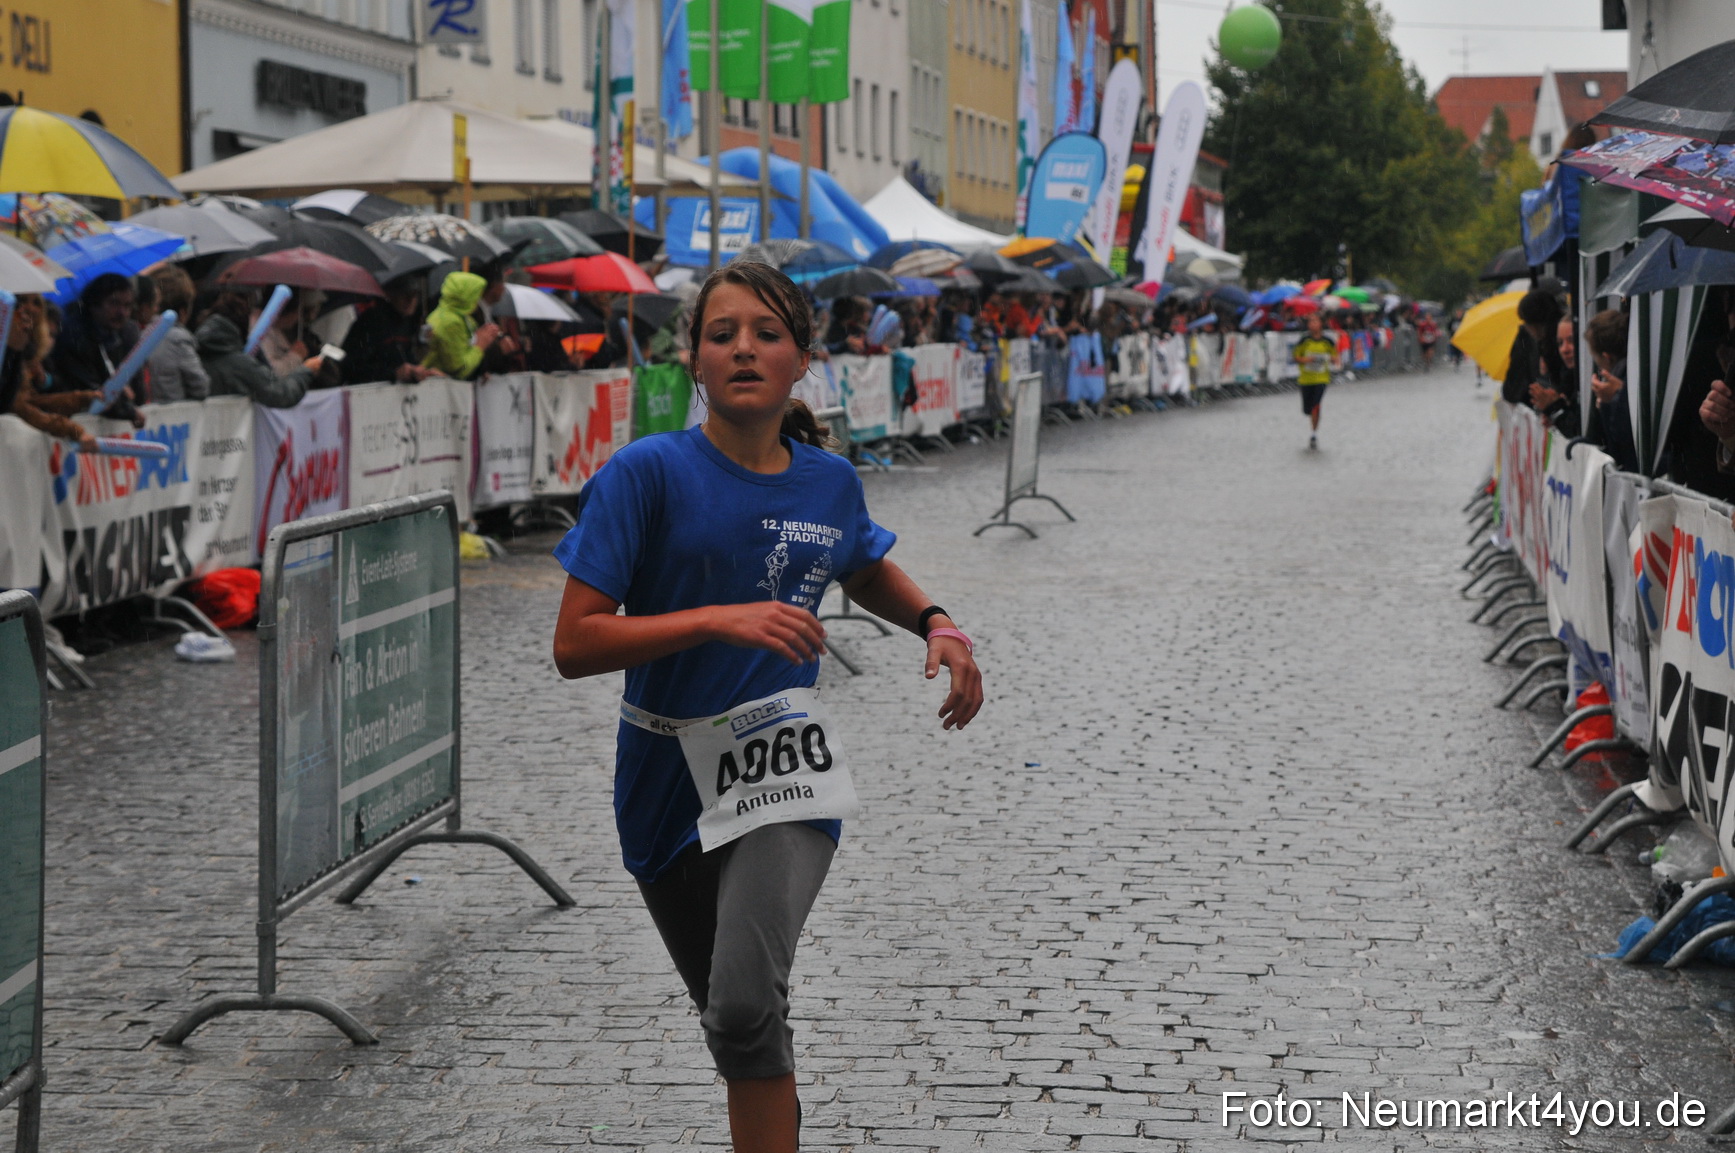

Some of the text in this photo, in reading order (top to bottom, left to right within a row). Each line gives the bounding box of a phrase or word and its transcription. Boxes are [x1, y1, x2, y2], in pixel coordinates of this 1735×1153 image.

[762, 519, 843, 541] 12. NEUMARKTER
[780, 531, 835, 549] STADTLAUF
[366, 647, 375, 691] &
[376, 637, 406, 688] Action
[731, 697, 791, 732] BOCK
[344, 714, 387, 766] sicheren
[716, 723, 833, 797] 4060
[736, 782, 815, 816] Antonia
